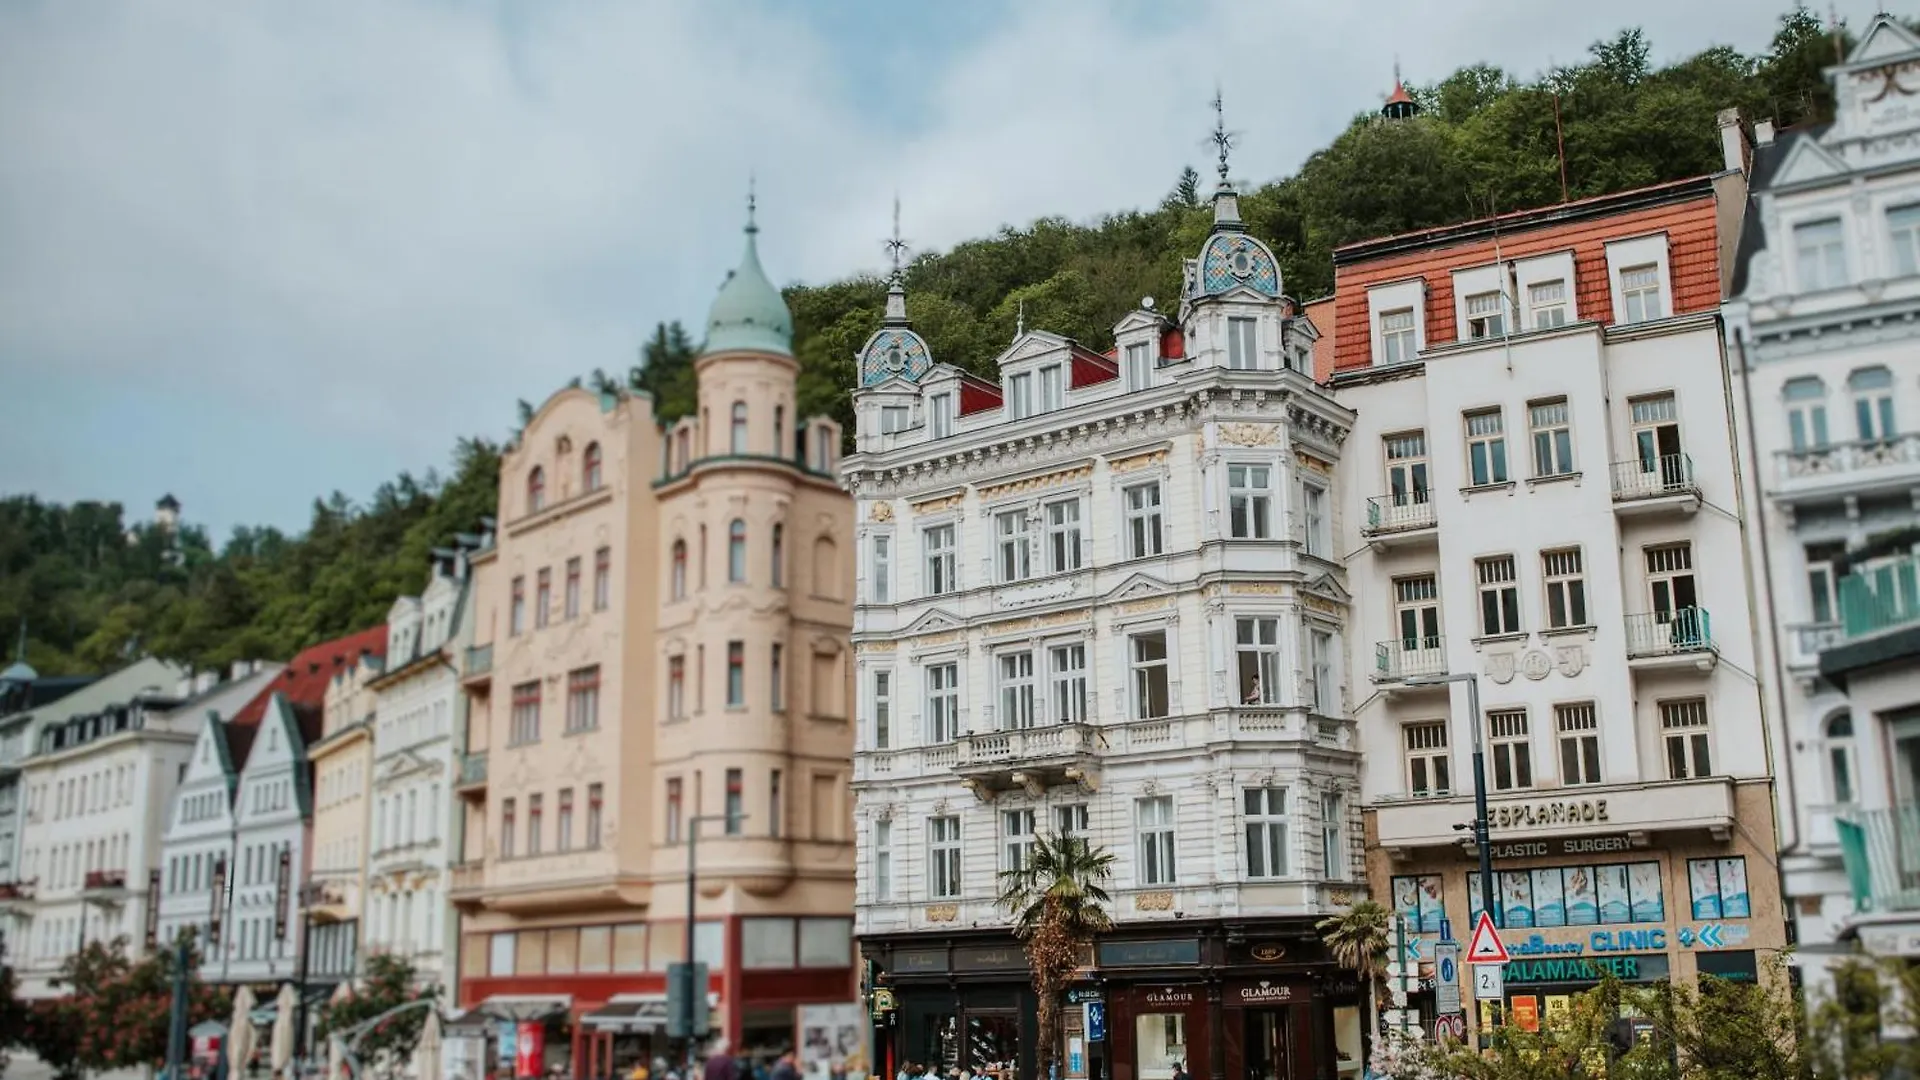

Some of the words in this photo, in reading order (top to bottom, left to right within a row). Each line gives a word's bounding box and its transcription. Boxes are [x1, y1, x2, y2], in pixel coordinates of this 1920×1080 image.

[1488, 800, 1609, 828] ESPLANADE
[1490, 842, 1547, 858] PLASTIC
[1564, 837, 1632, 853] SURGERY
[1590, 928, 1667, 952] CLINIC
[1146, 993, 1193, 1002] GLAMOUR
[1241, 986, 1291, 998] GLAMOUR
